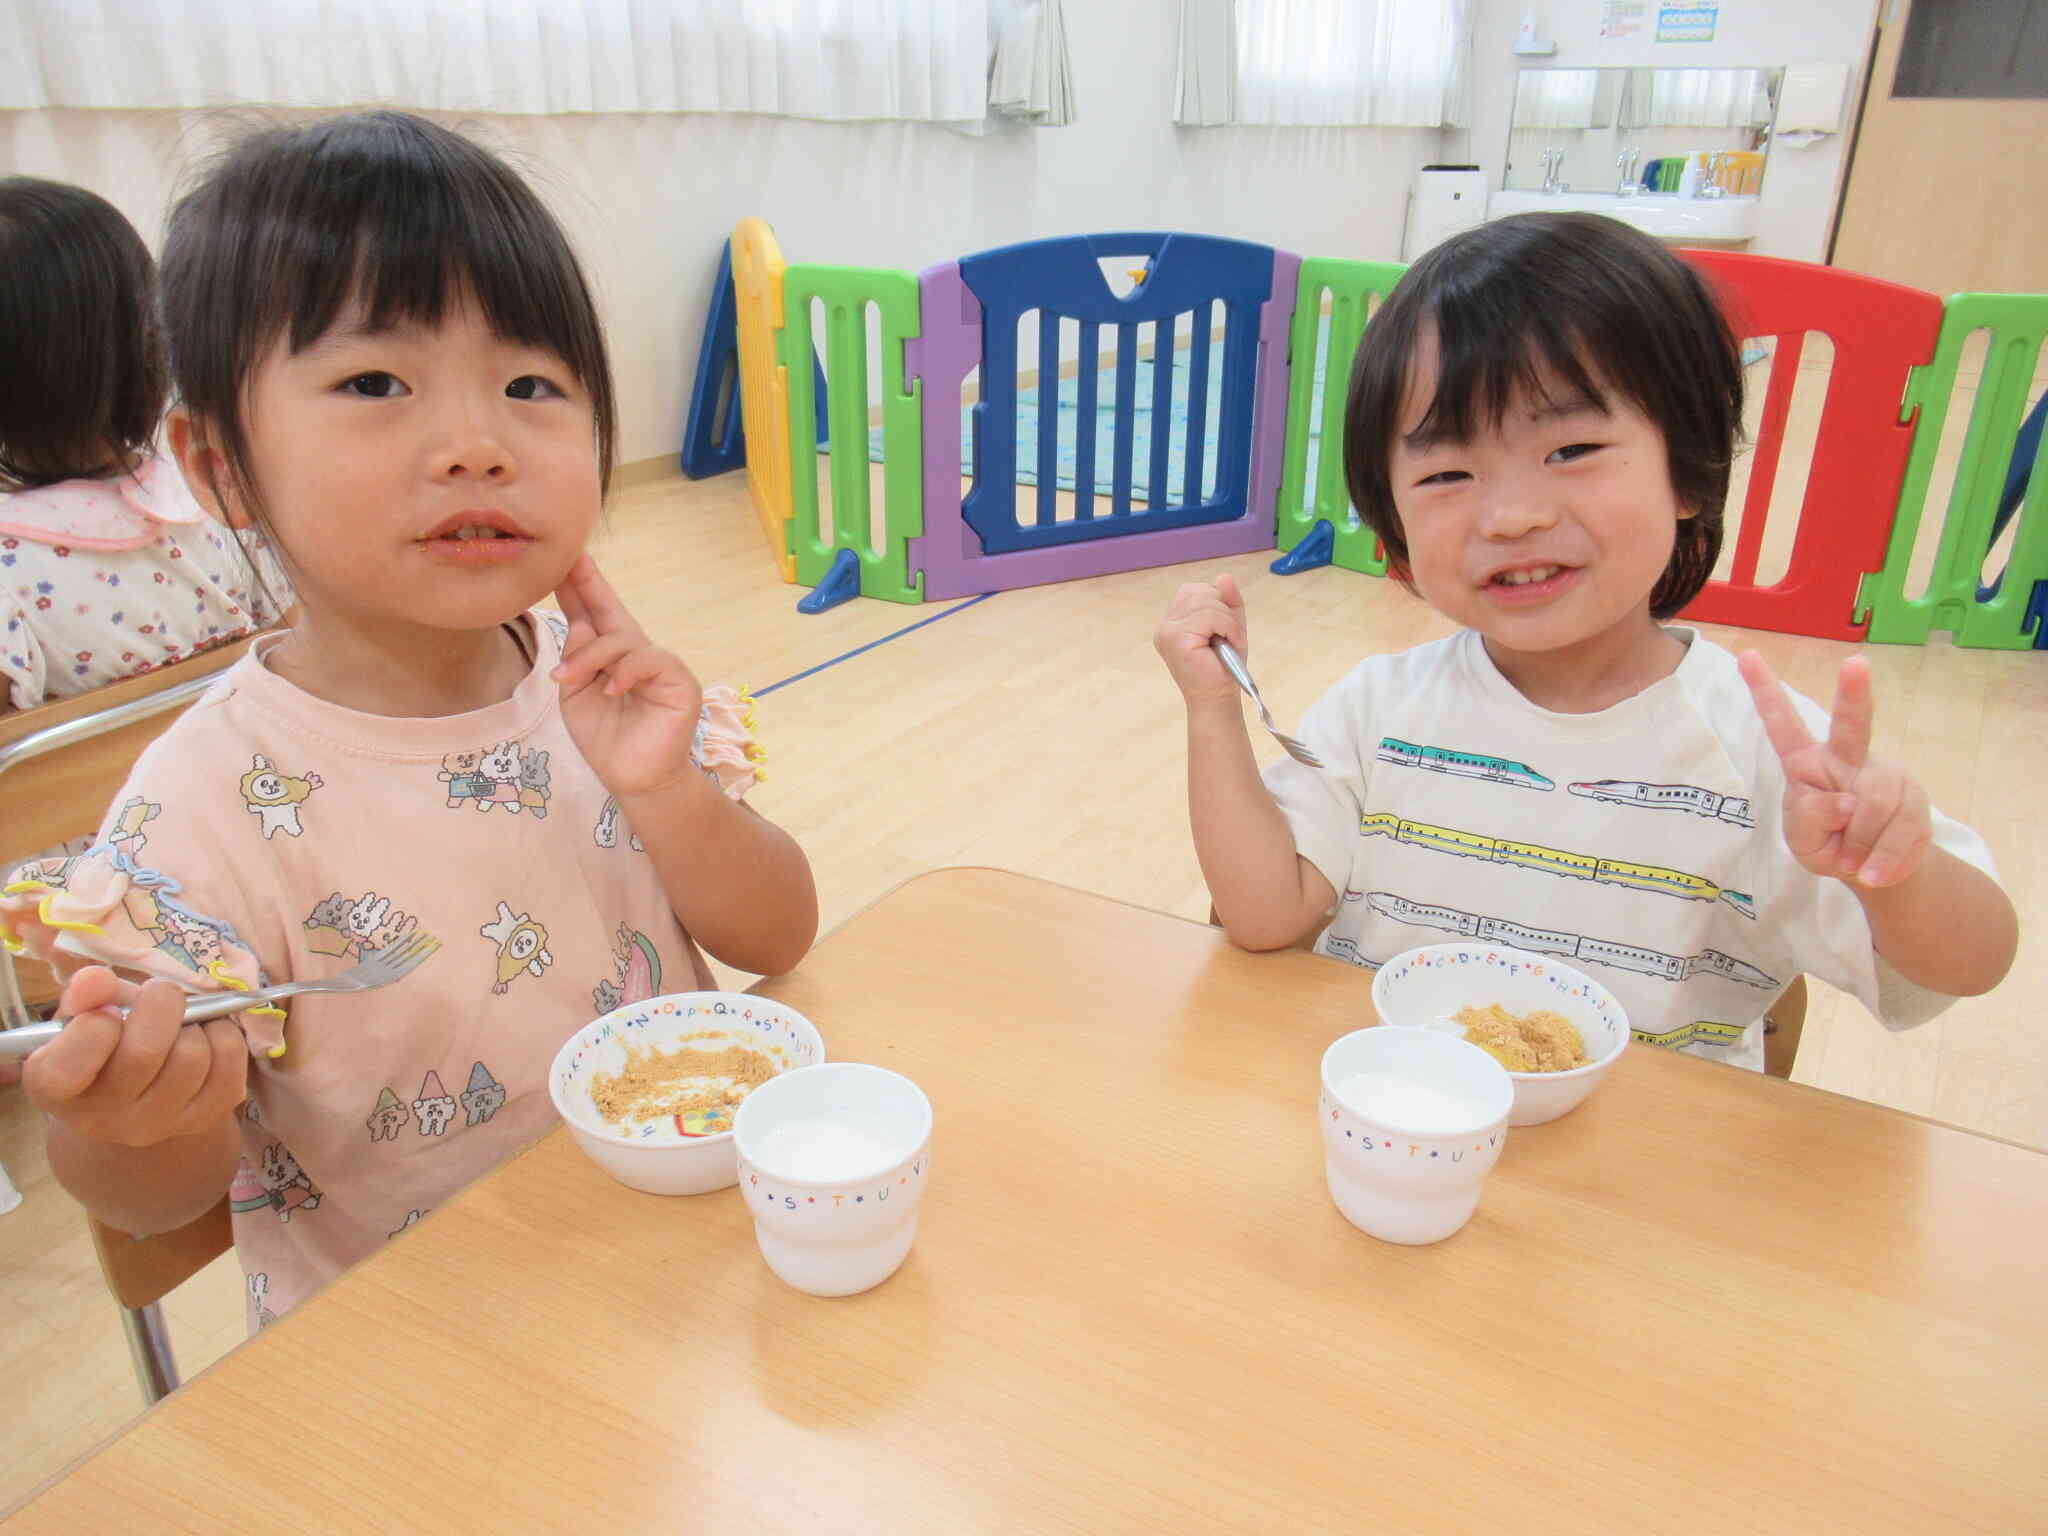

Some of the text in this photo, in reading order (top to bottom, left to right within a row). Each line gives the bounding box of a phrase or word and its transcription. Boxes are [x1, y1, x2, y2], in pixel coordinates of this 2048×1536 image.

[1458, 952, 1469, 964] D
[1486, 953, 1497, 965] E
[1510, 964, 1520, 977] F
[1583, 984, 1591, 997] I
[635, 1013, 649, 1028] N
[663, 1002, 674, 1014] O
[713, 1002, 728, 1015] Q
[763, 1019, 772, 1031] S
[1362, 1136, 1373, 1150] S
[1408, 1144, 1421, 1157] T
[1451, 1151, 1464, 1163] U
[784, 1195, 796, 1209] S
[832, 1195, 844, 1206] T
[878, 1187, 889, 1200] U
